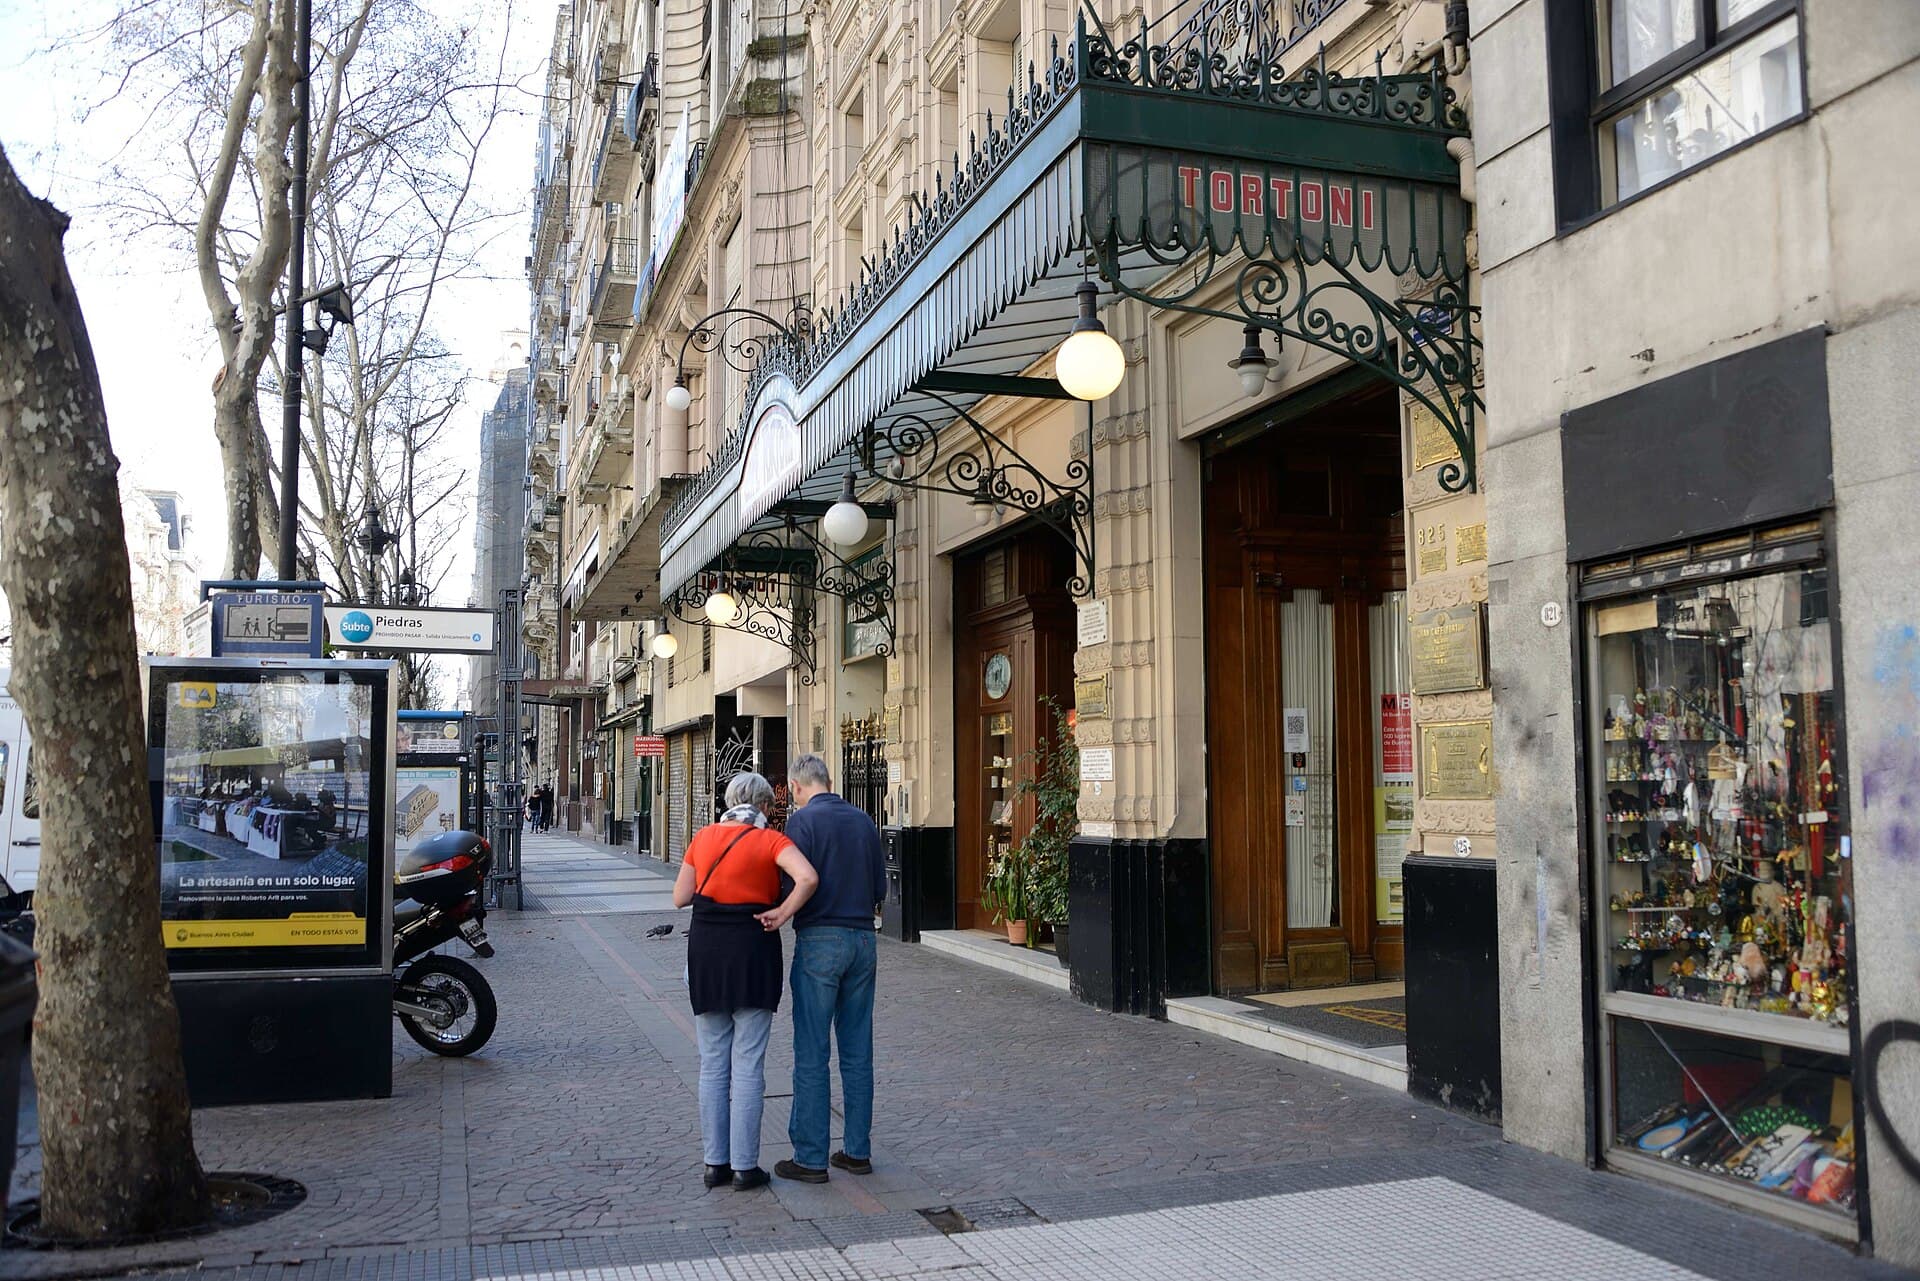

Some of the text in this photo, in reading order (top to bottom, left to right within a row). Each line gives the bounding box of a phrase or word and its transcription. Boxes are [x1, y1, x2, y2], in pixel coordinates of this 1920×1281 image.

[1178, 166, 1374, 230] TORTONI
[1418, 523, 1446, 545] 825
[237, 594, 301, 604] TURISMO
[342, 622, 370, 632] Subte
[376, 616, 423, 628] Piedras
[180, 875, 356, 887] La artesanía en un solo lugar.
[222, 895, 240, 903] plaza
